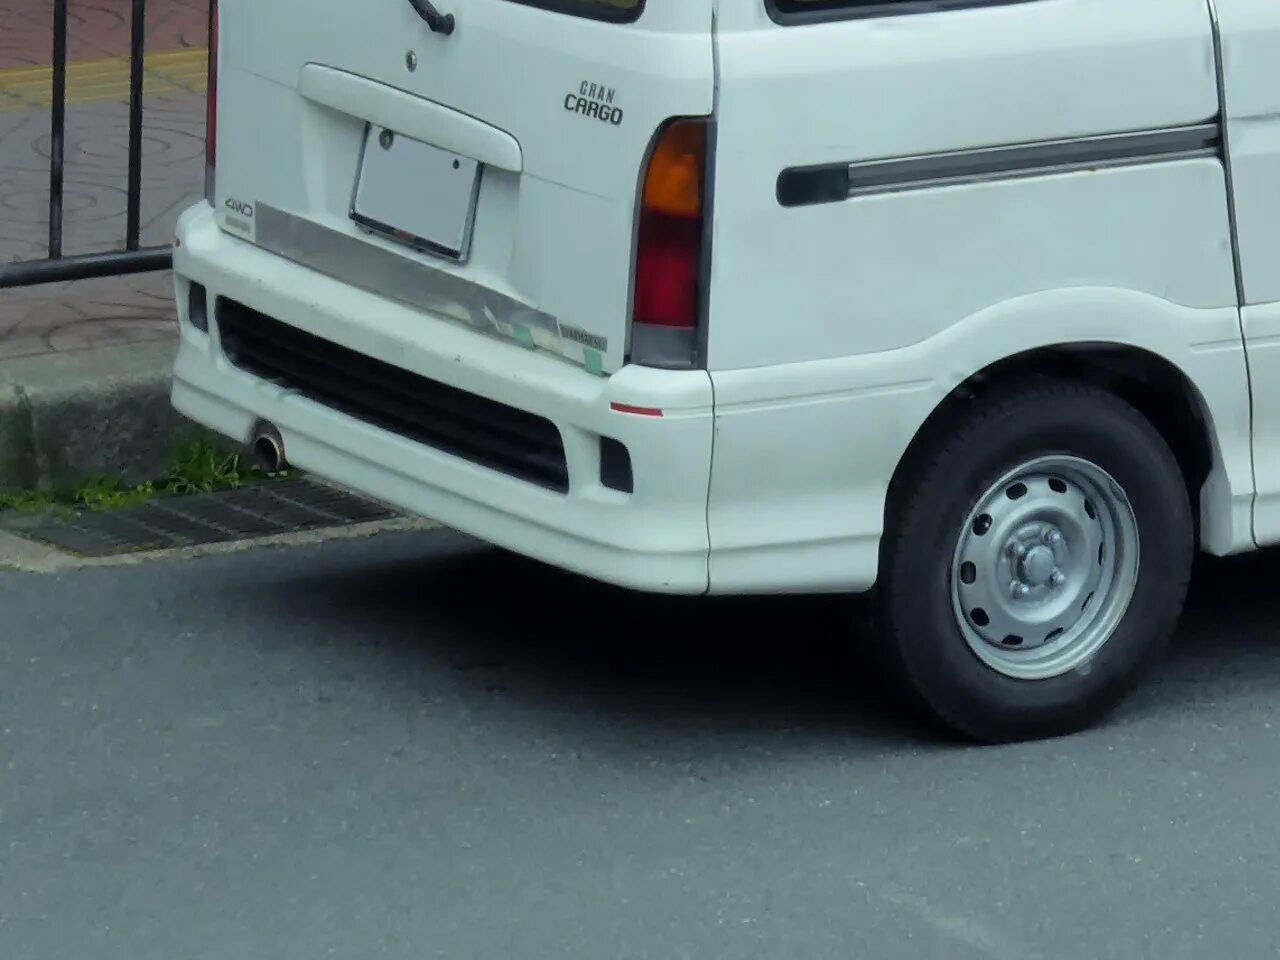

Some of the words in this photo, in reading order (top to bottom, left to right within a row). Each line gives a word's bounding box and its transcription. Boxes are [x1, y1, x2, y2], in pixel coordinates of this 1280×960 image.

[580, 80, 615, 104] GRAN
[564, 93, 624, 126] CARGO
[225, 198, 253, 217] 4WD
